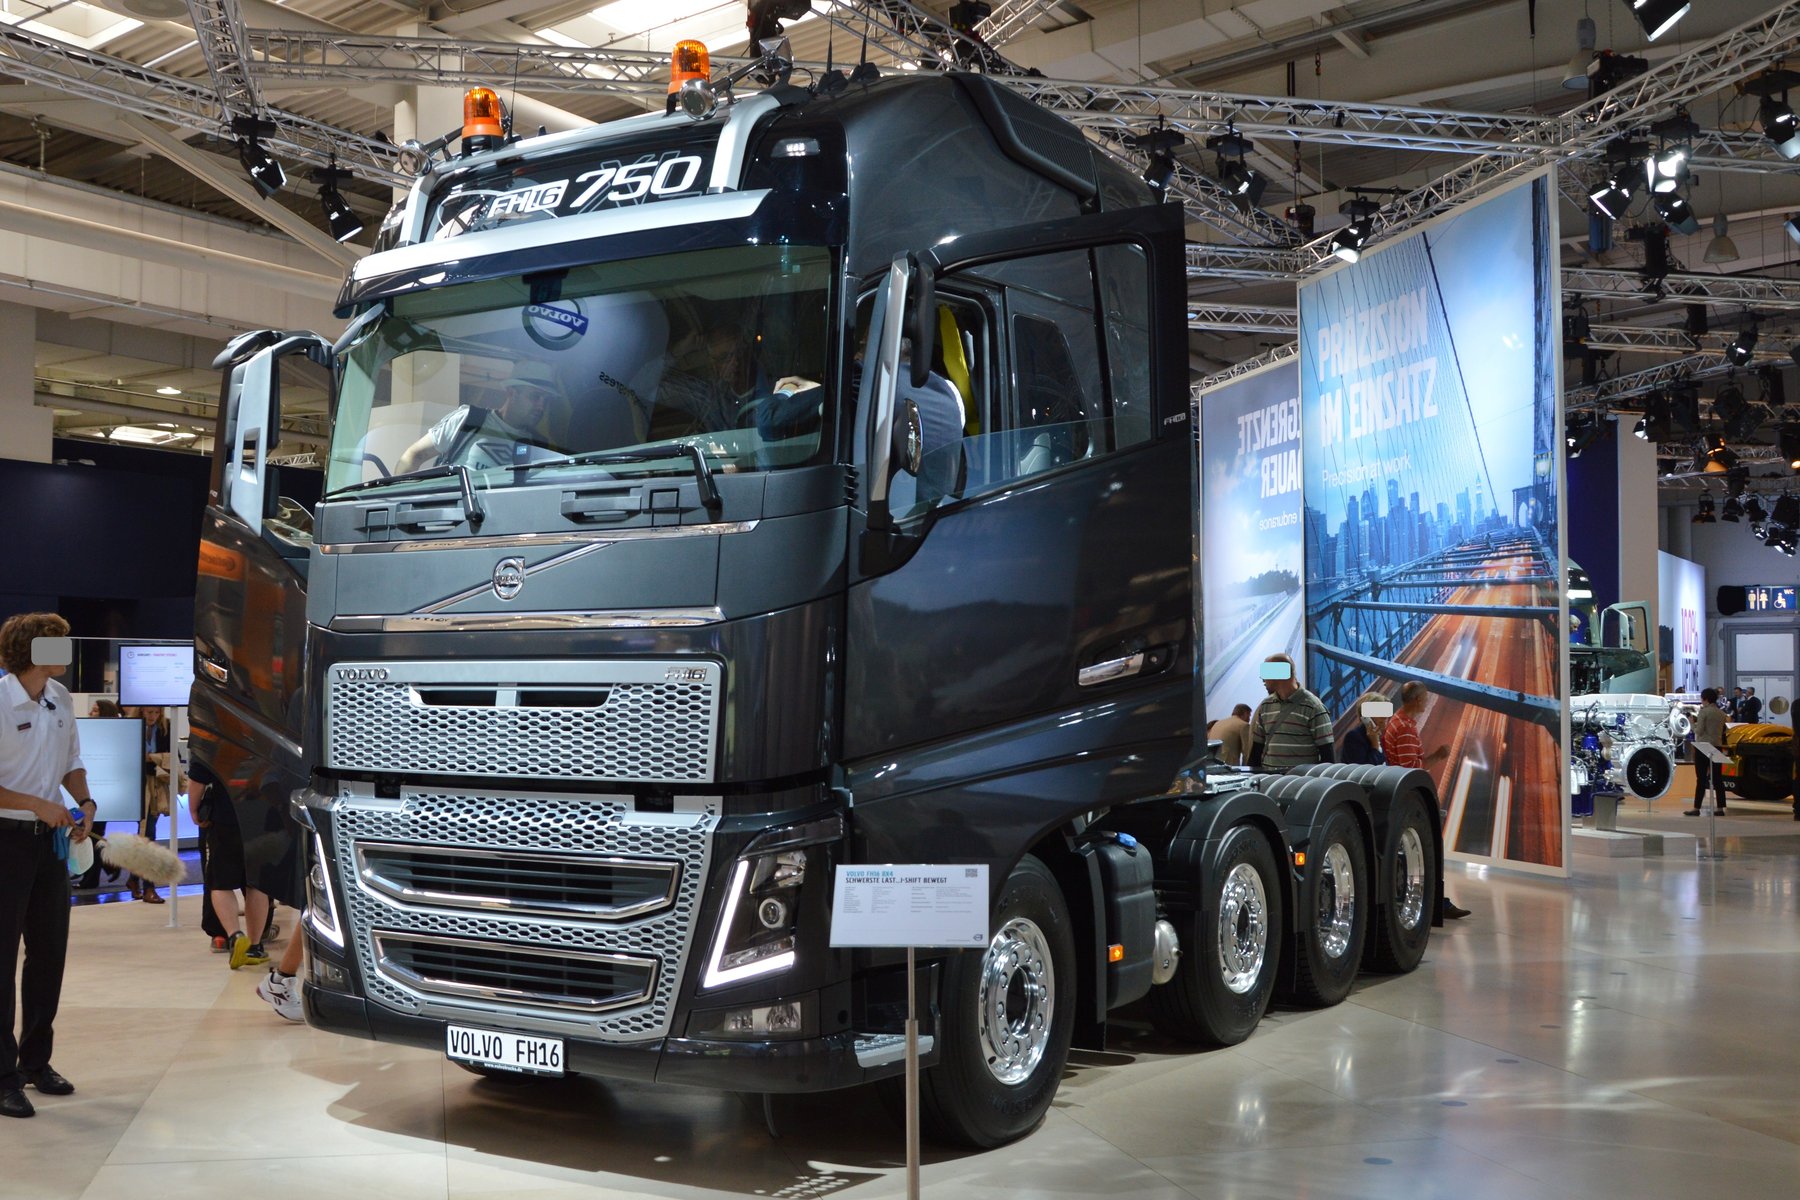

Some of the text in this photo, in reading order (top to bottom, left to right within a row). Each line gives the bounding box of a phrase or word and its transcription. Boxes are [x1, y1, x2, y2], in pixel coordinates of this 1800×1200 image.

[487, 156, 702, 218] FH16 750
[1319, 286, 1428, 382] PRÄZISION
[1320, 356, 1438, 448] IM EINSATZ
[1322, 449, 1411, 488] Precision at work
[336, 668, 390, 681] VOLVO
[665, 667, 707, 682] FH16
[846, 870, 865, 878] VOLVO
[450, 1029, 560, 1068] VOLVO FH16
